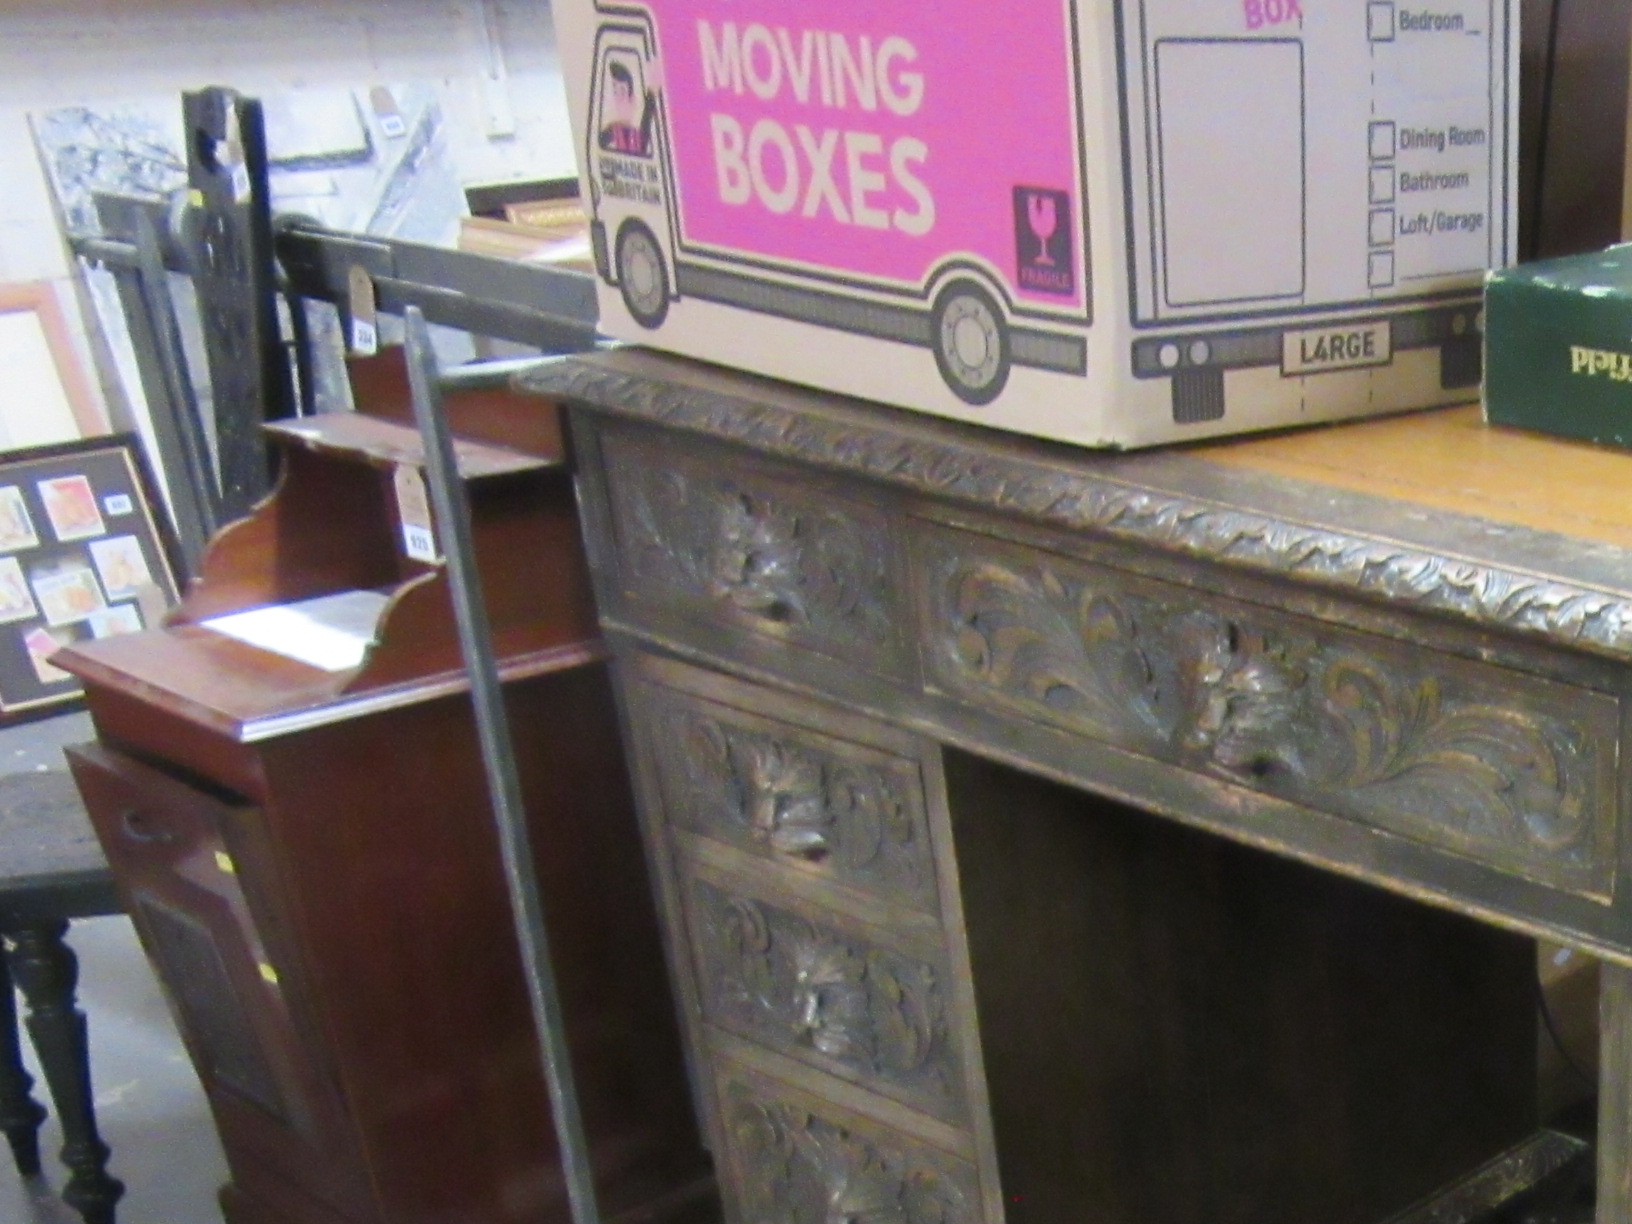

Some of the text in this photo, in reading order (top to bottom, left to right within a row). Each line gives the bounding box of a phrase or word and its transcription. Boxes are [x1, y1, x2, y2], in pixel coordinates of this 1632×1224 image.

[1400, 9, 1464, 31] Bedroom
[696, 19, 925, 116] MOVING
[1400, 126, 1486, 152] Dining Room
[710, 112, 937, 236] BOXES
[1400, 172, 1470, 192] Bathroom
[1400, 209, 1484, 236] Loft/Garage
[1021, 266, 1072, 290] FRAGILE
